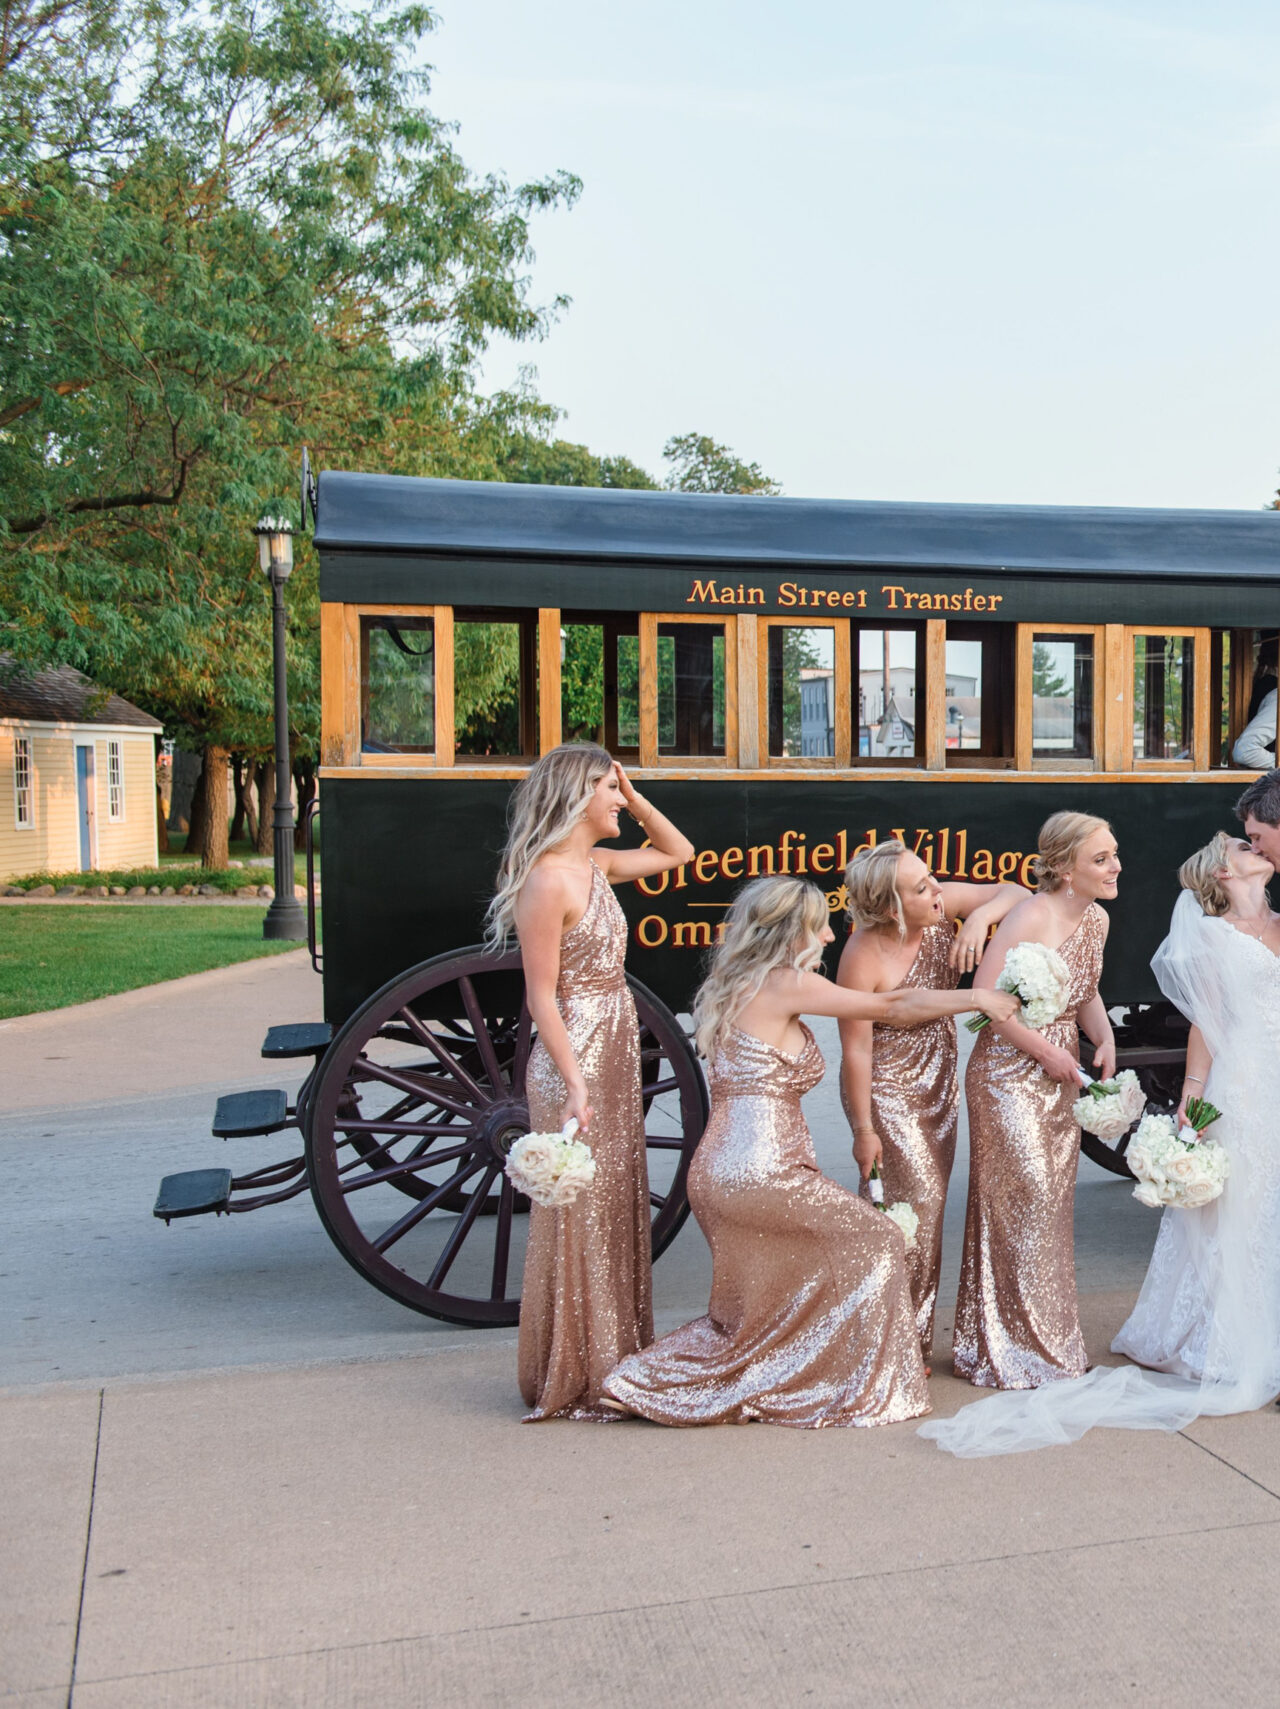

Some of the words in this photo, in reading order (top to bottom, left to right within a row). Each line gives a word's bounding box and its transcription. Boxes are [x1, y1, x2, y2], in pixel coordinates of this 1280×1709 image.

[686, 579, 766, 605] Main
[778, 582, 868, 608] Street
[881, 585, 1003, 612] Transfer
